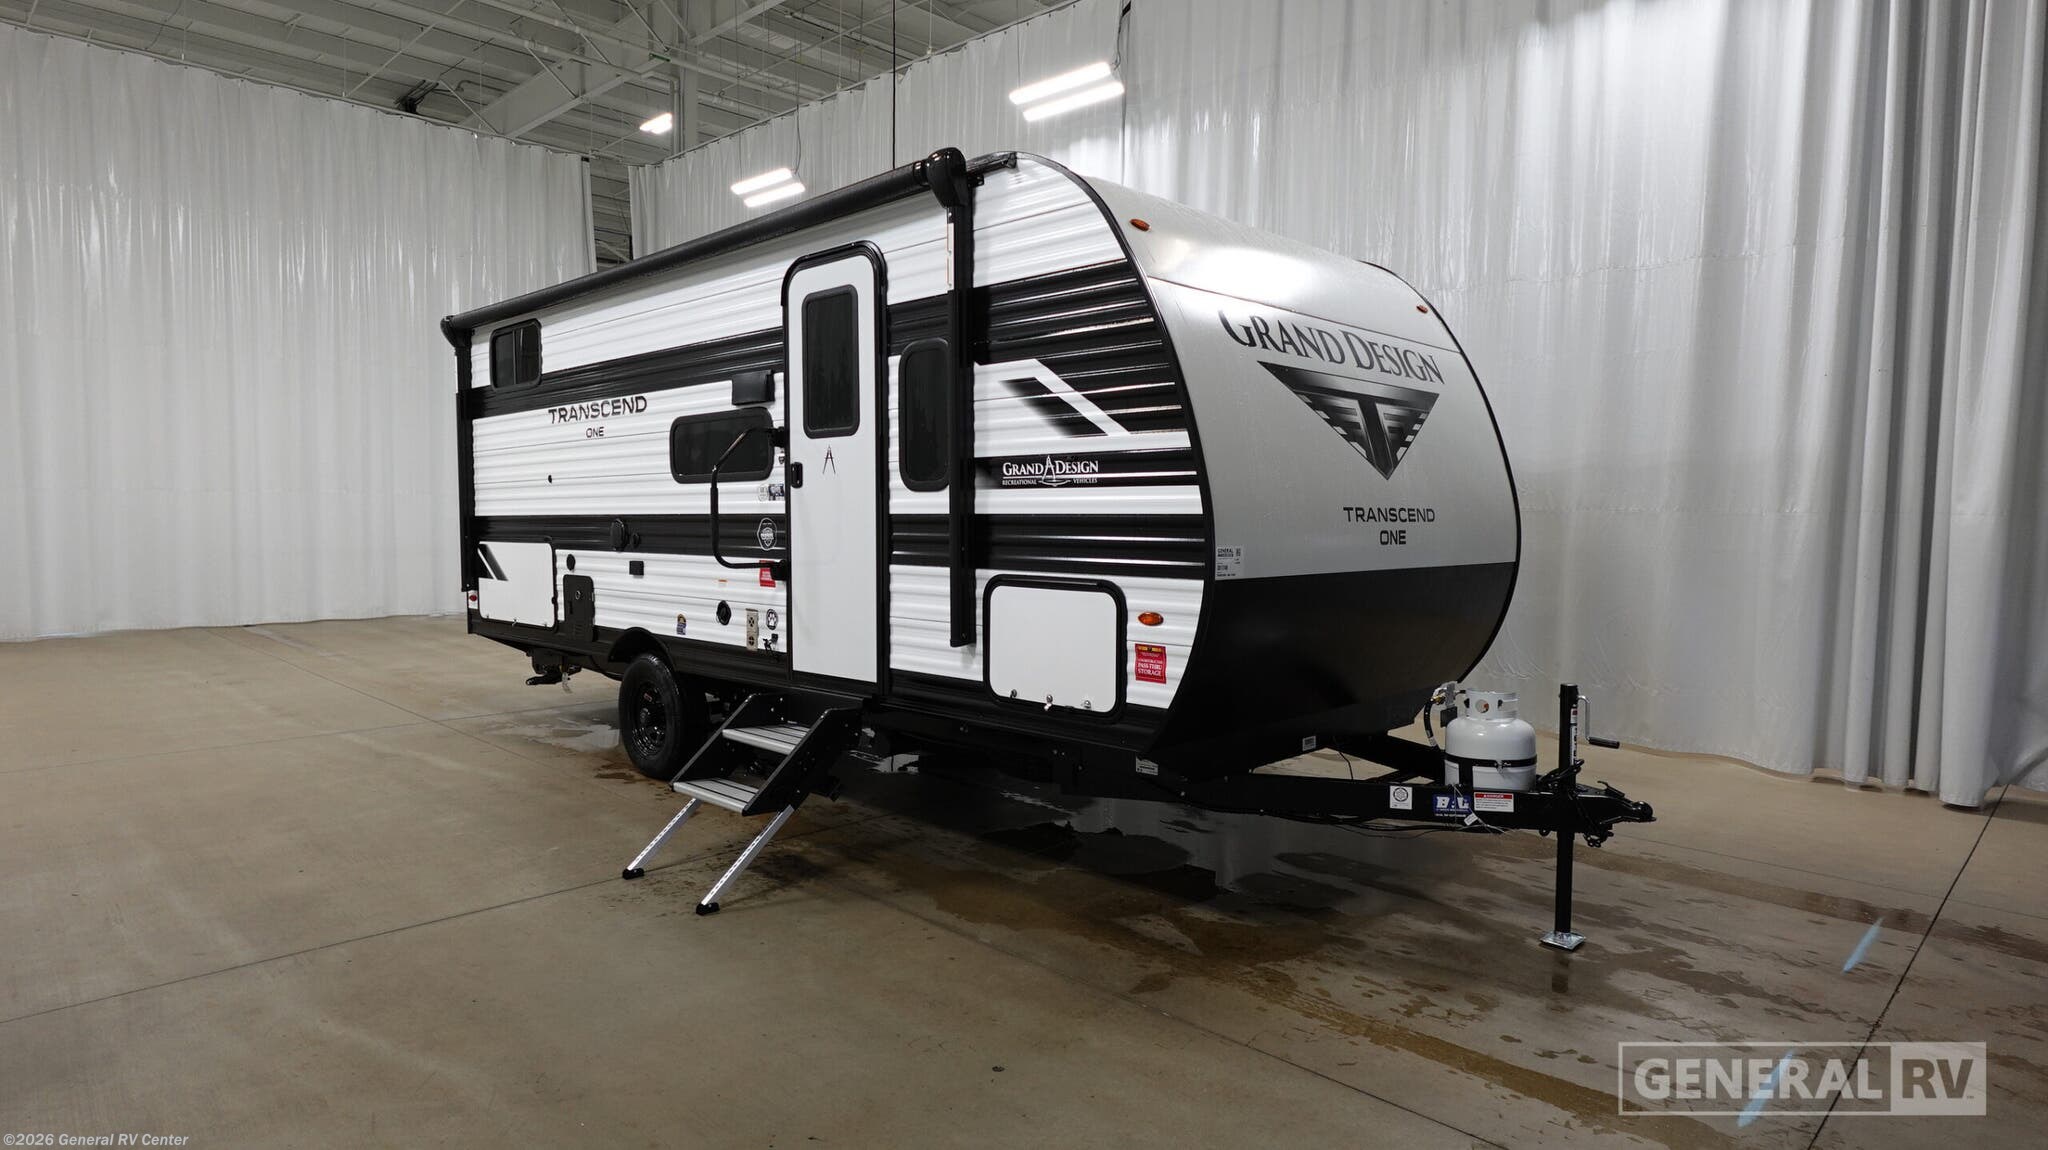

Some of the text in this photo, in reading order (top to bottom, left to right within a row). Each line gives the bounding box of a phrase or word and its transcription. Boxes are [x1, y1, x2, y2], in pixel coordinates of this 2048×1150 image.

[1218, 309, 1445, 385] GRAND DESIGN
[548, 395, 648, 424] TRANSCEND
[586, 426, 605, 439] ONE
[1002, 460, 1099, 476] GRAND DESIGN
[1343, 507, 1435, 523] TRANSCEND
[1380, 530, 1406, 545] ONE
